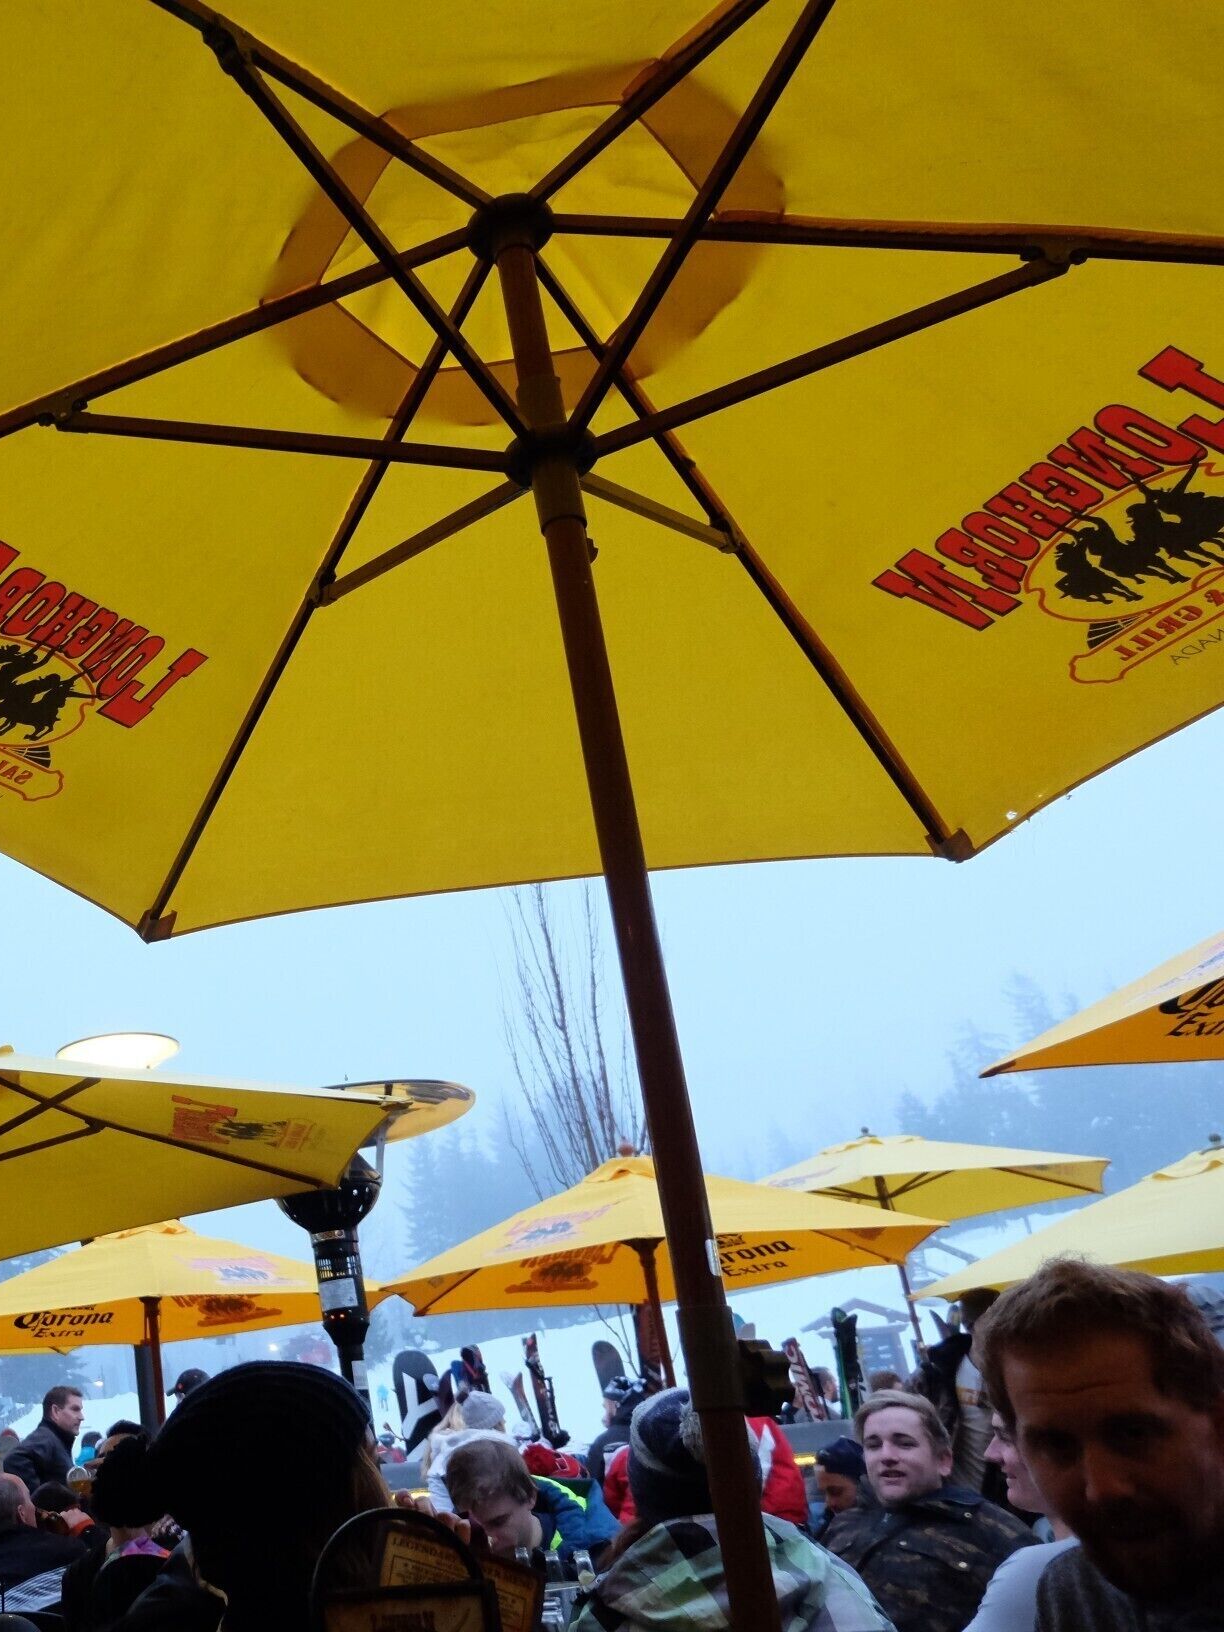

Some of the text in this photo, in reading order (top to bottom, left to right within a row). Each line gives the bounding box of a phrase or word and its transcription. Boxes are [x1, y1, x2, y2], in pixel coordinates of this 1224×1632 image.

[719, 1240, 795, 1265] rona
[722, 1261, 788, 1277] Extra
[14, 1311, 114, 1331] Corona
[33, 1327, 85, 1338] Extra
